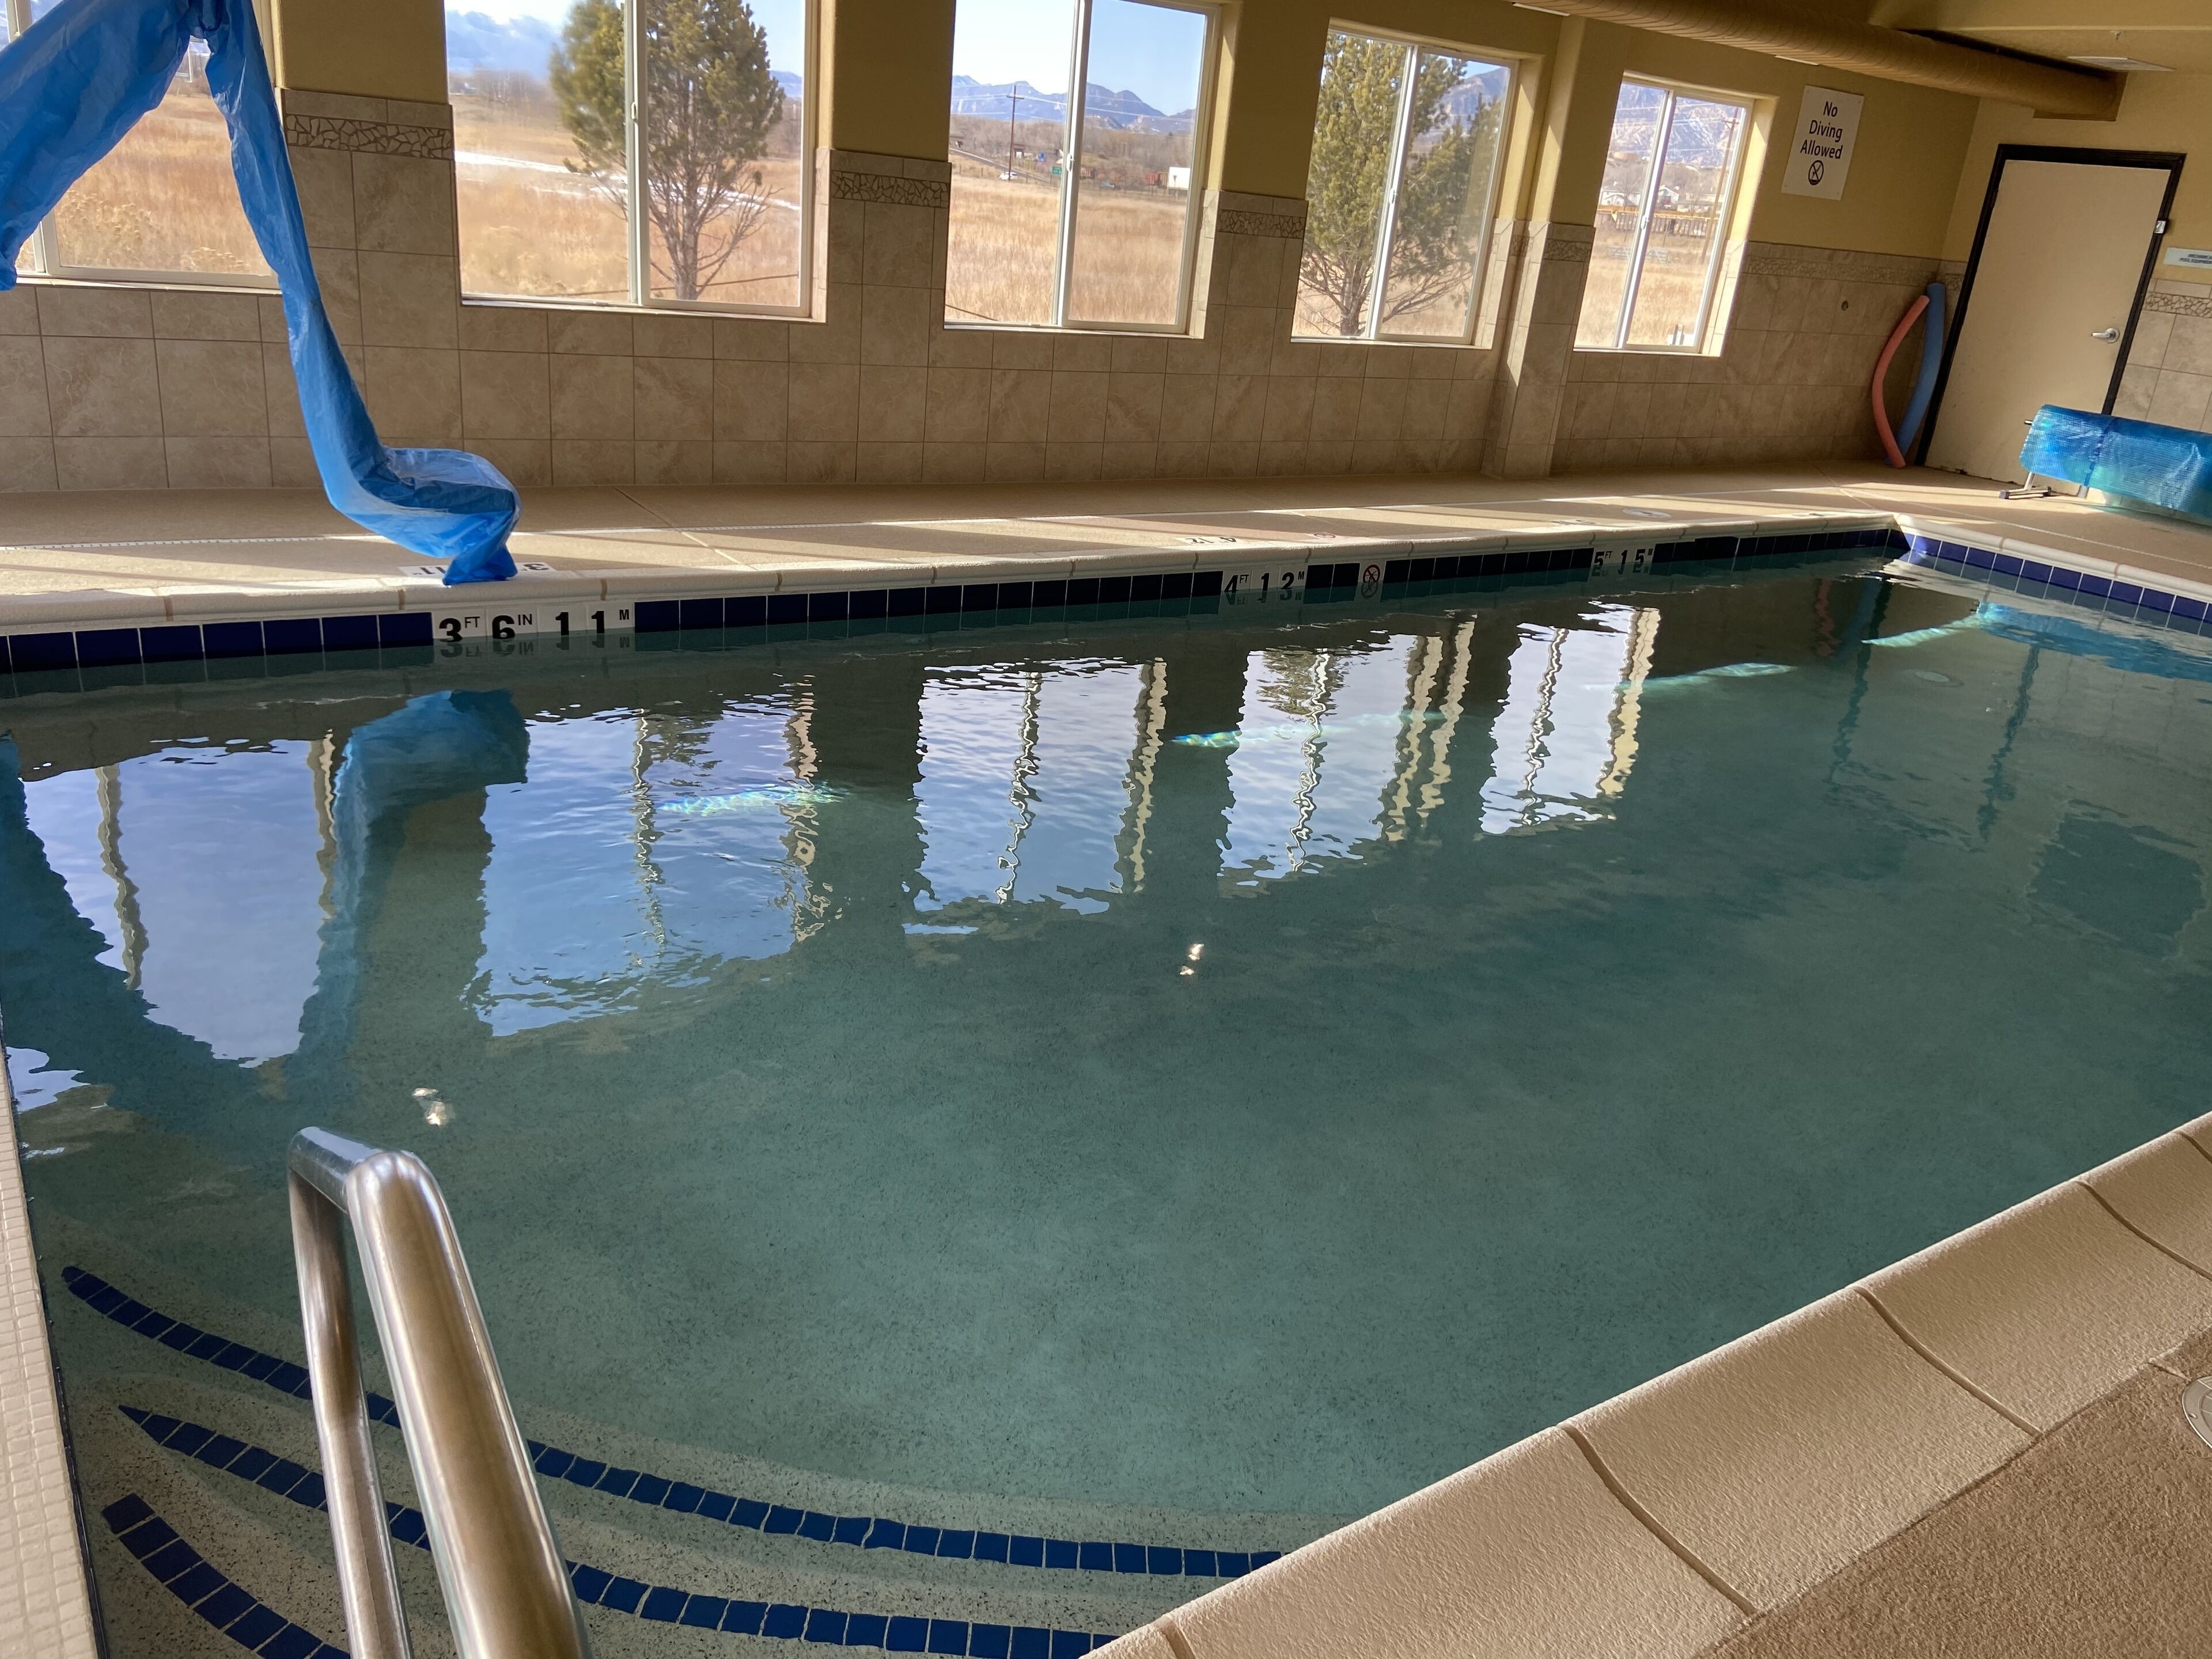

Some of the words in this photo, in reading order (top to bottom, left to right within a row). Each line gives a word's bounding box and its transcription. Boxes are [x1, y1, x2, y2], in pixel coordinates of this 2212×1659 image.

[1823, 101, 1838, 117] No
[1809, 120, 1843, 143] Diving
[1800, 139, 1843, 159] Allowed
[1239, 574, 1249, 584] FT
[439, 618, 463, 642] 3
[464, 616, 480, 628] FT
[492, 615, 516, 639] 6
[518, 613, 533, 626] IN
[619, 609, 630, 620] M
